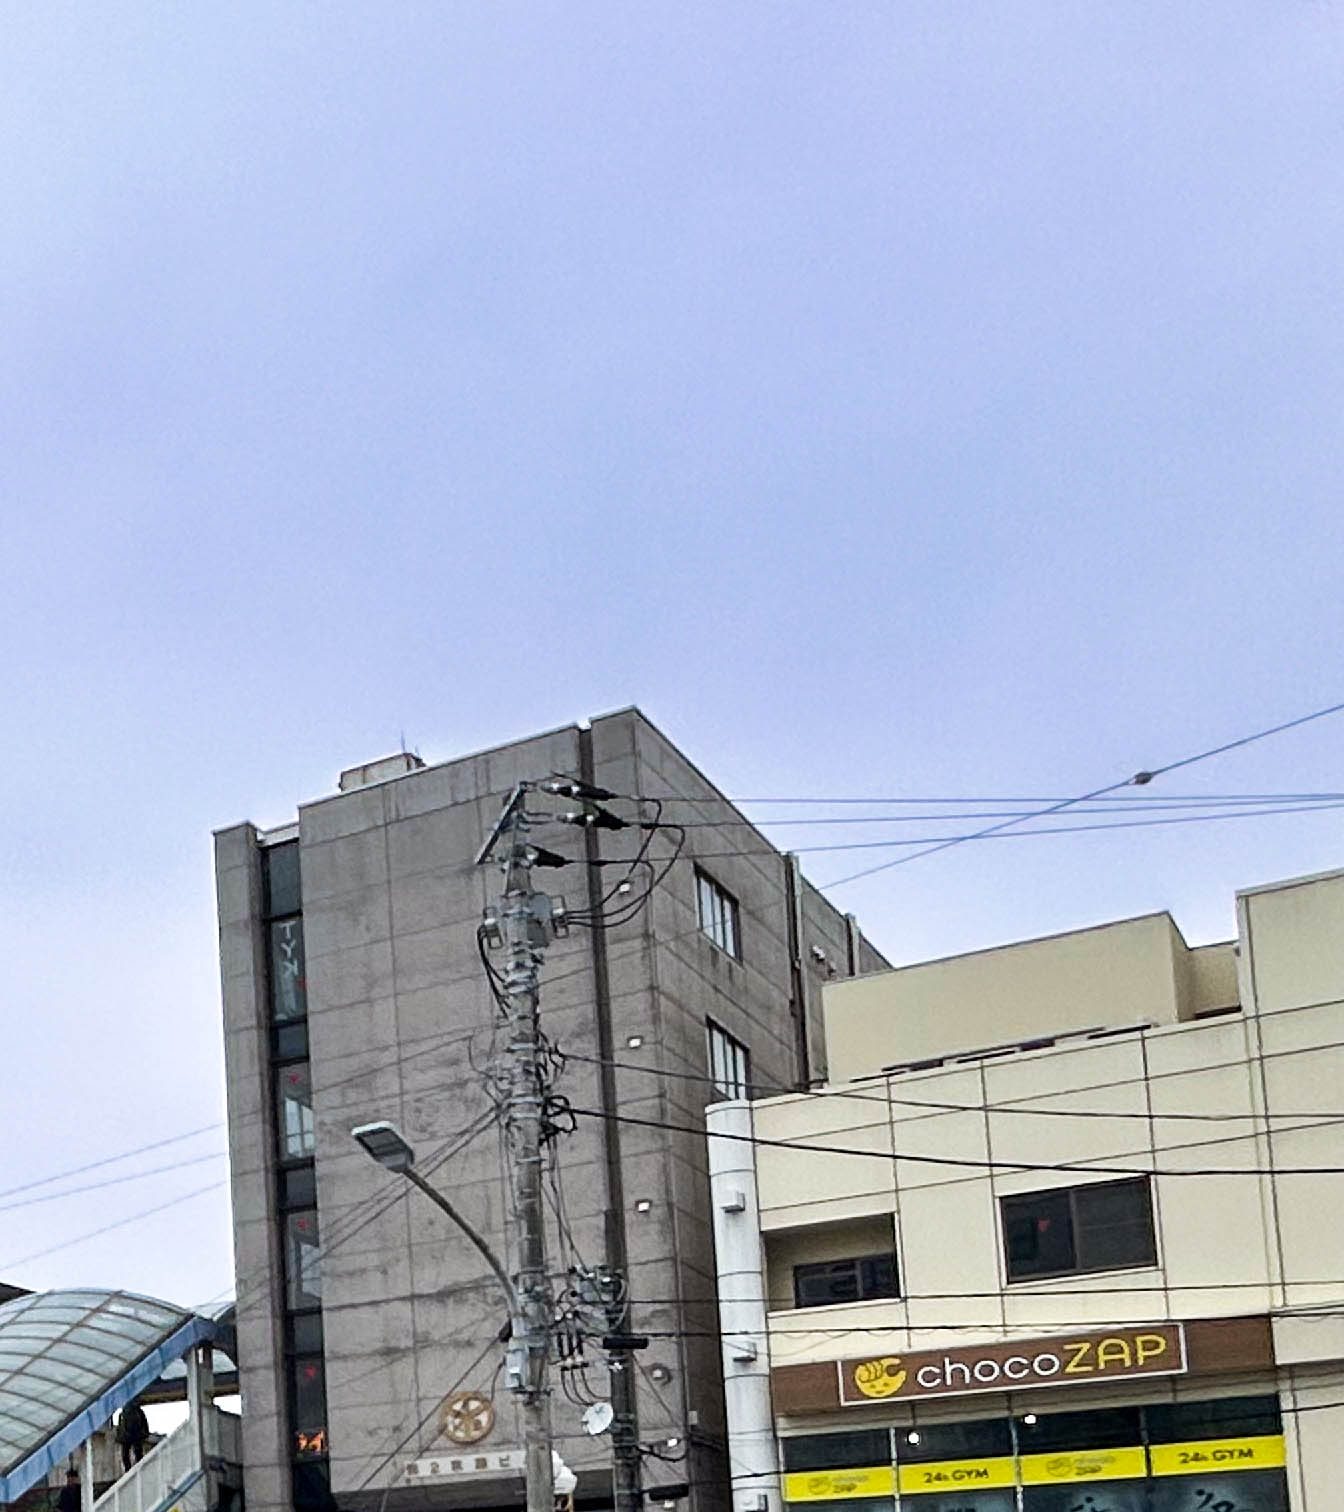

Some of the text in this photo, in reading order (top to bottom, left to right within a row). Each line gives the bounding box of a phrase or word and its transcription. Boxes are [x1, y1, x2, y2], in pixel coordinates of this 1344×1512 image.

[916, 1334, 1167, 1388] chocoZAP
[1212, 1448, 1255, 1462] GYM
[952, 1468, 990, 1481] GYM
